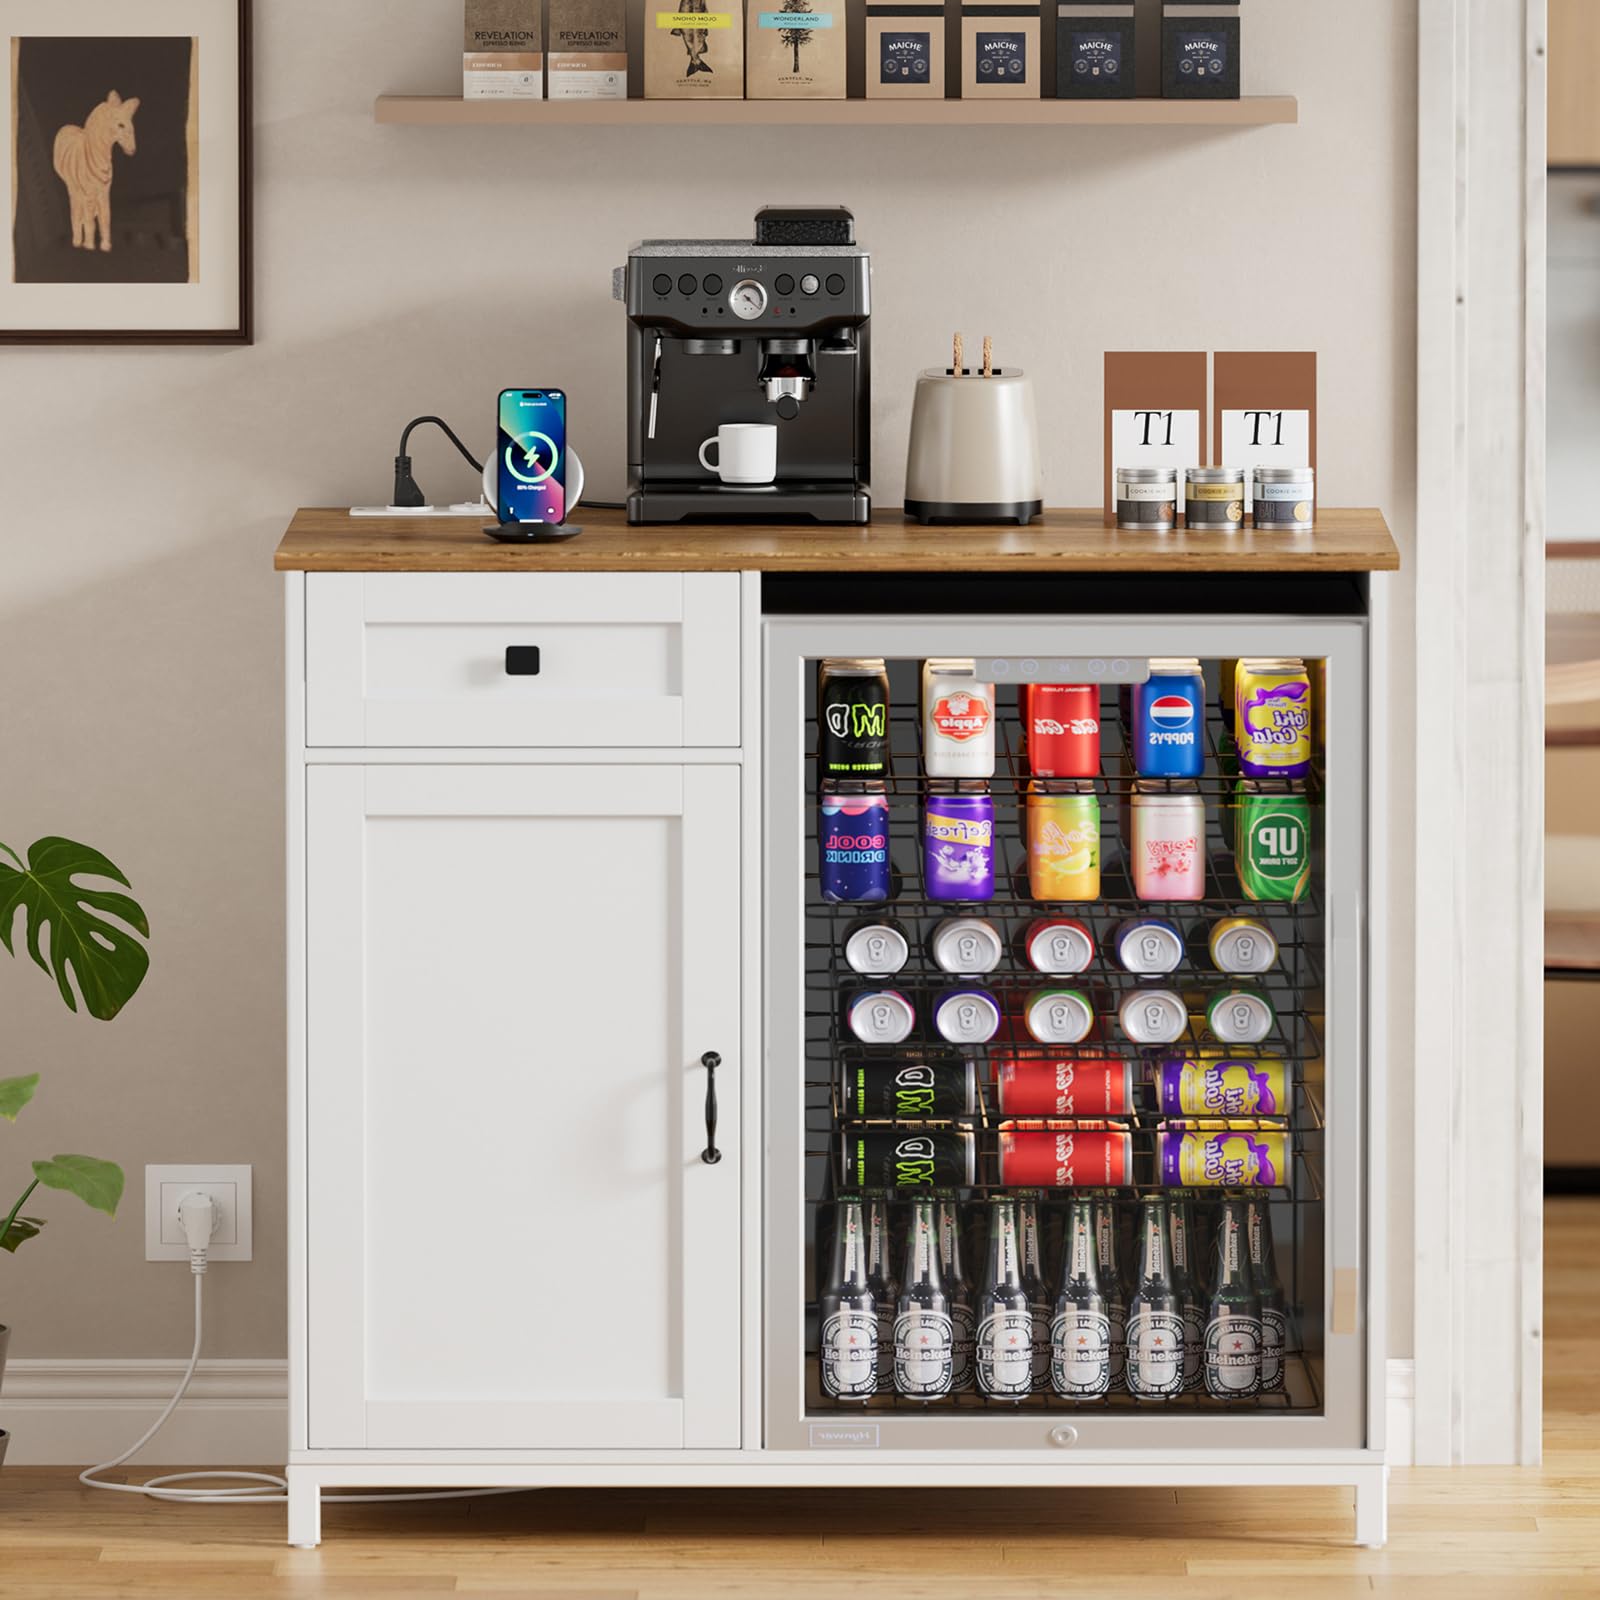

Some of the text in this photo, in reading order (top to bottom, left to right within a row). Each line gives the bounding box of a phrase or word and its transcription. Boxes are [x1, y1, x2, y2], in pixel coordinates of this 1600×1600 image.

[474, 31, 534, 40] REVELATION
[559, 31, 618, 40] REVELATION
[888, 41, 923, 52] MAICHE
[984, 41, 1019, 52] MAICHE
[1079, 41, 1113, 52] MAICHE
[1184, 41, 1219, 52] MAICHE
[1134, 411, 1175, 446] T1
[1244, 411, 1285, 446] T1
[1230, 1232, 1239, 1271] Heineken
[895, 1347, 952, 1361] Heineken
[982, 1349, 1032, 1361] Heineke
[1053, 1348, 1109, 1361] Heineken
